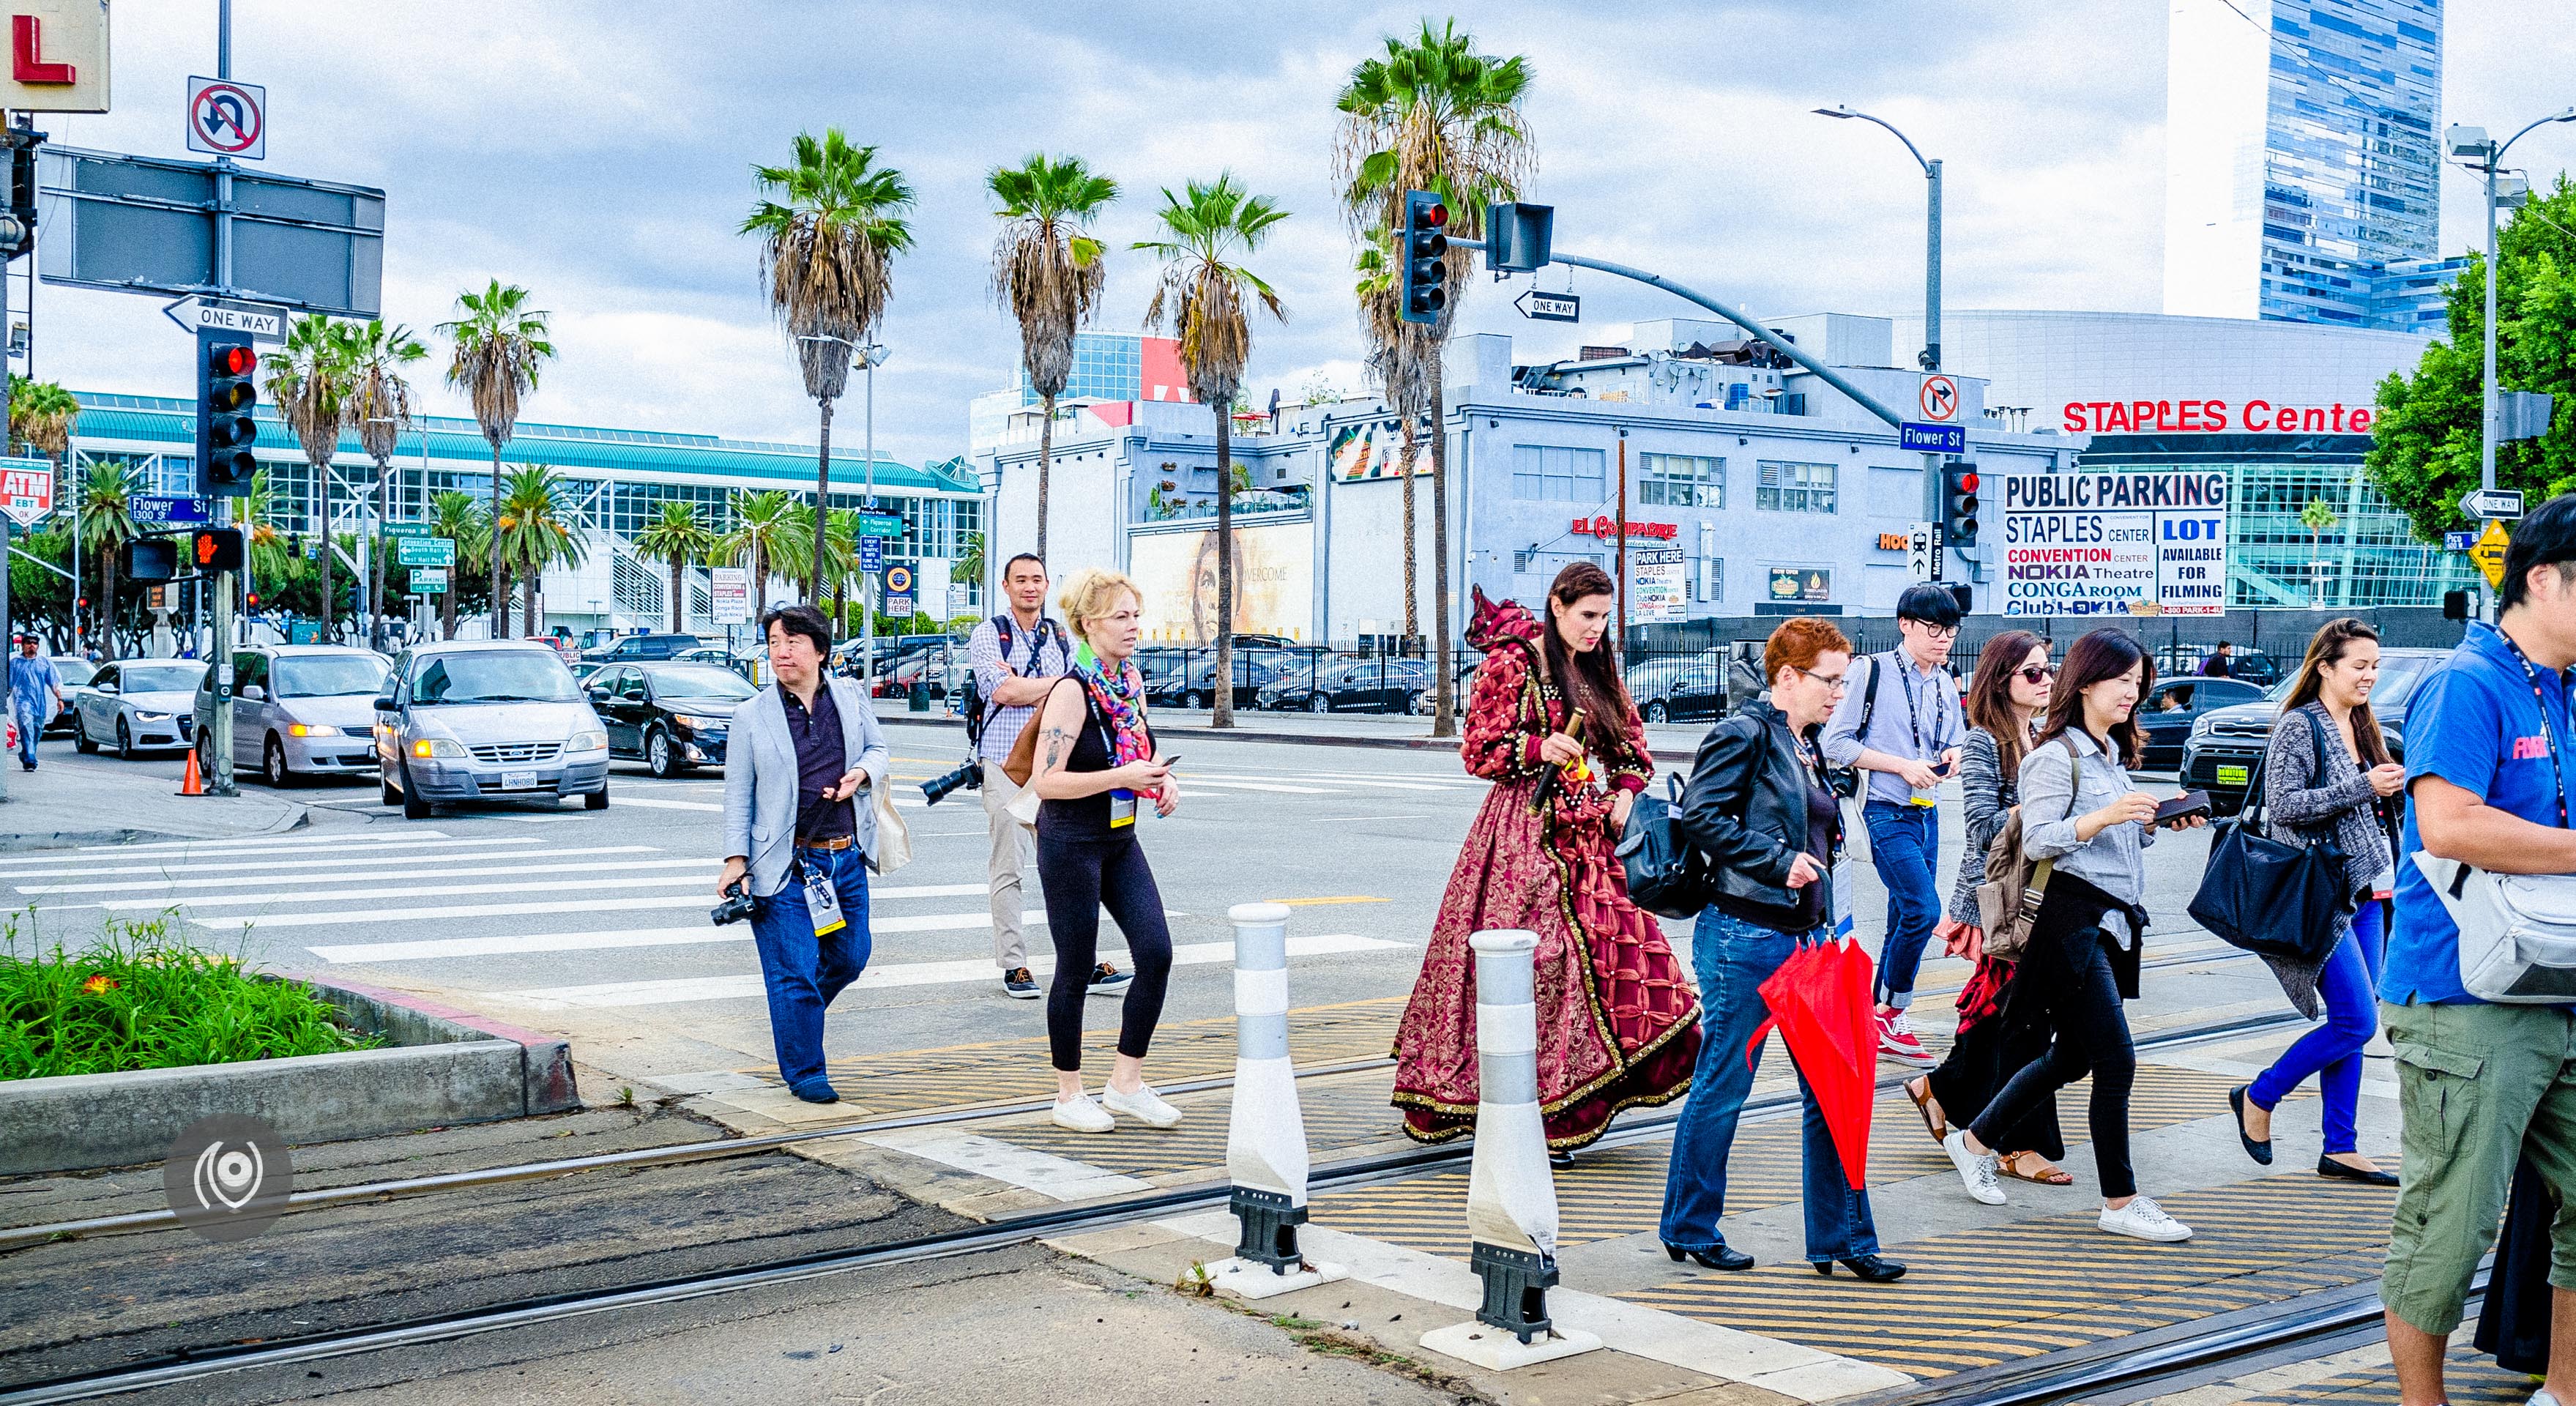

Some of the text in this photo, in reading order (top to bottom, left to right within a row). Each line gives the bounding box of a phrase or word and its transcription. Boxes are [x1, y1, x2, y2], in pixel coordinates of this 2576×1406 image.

[12, 15, 76, 85] L
[1533, 300, 1573, 313] ONE WAY
[201, 310, 274, 331] ONE WAY
[2063, 400, 2380, 432] STAPLES Cente
[1905, 428, 1961, 447] Flower St
[2, 471, 48, 497] ATM
[2006, 474, 2224, 507] PUBLIC PARKING
[15, 499, 34, 508] EBT
[133, 497, 206, 513] Flower St
[2483, 499, 2516, 510] ONE WAY
[133, 510, 154, 519] 1300
[870, 518, 892, 527] Figueroa
[1572, 517, 1594, 534] EL
[2006, 515, 2149, 543] STAPLES CENTER
[2163, 518, 2221, 540] LOT
[384, 527, 417, 535] Figueroa
[2446, 534, 2462, 543] Pico
[1637, 550, 1683, 565] PARK HERE
[1932, 529, 1942, 575] Metro Rail
[2008, 548, 2148, 563] CONVENTION CENTER
[2162, 548, 2222, 562] AVAILABLE
[412, 570, 444, 583] PARKING
[1635, 565, 1665, 576] STAPLES
[2008, 564, 2154, 580] NOKIA Theatre
[2178, 566, 2205, 579] FOR
[1635, 577, 1656, 585] NOKIA
[1635, 586, 1667, 594] CONVENTION
[2008, 581, 2143, 598] CONGA ROOM
[2162, 584, 2222, 598] FILMING
[888, 598, 910, 606] PARK
[1648, 594, 1666, 602] NOKIA
[1861, 702, 1872, 724] Canon
